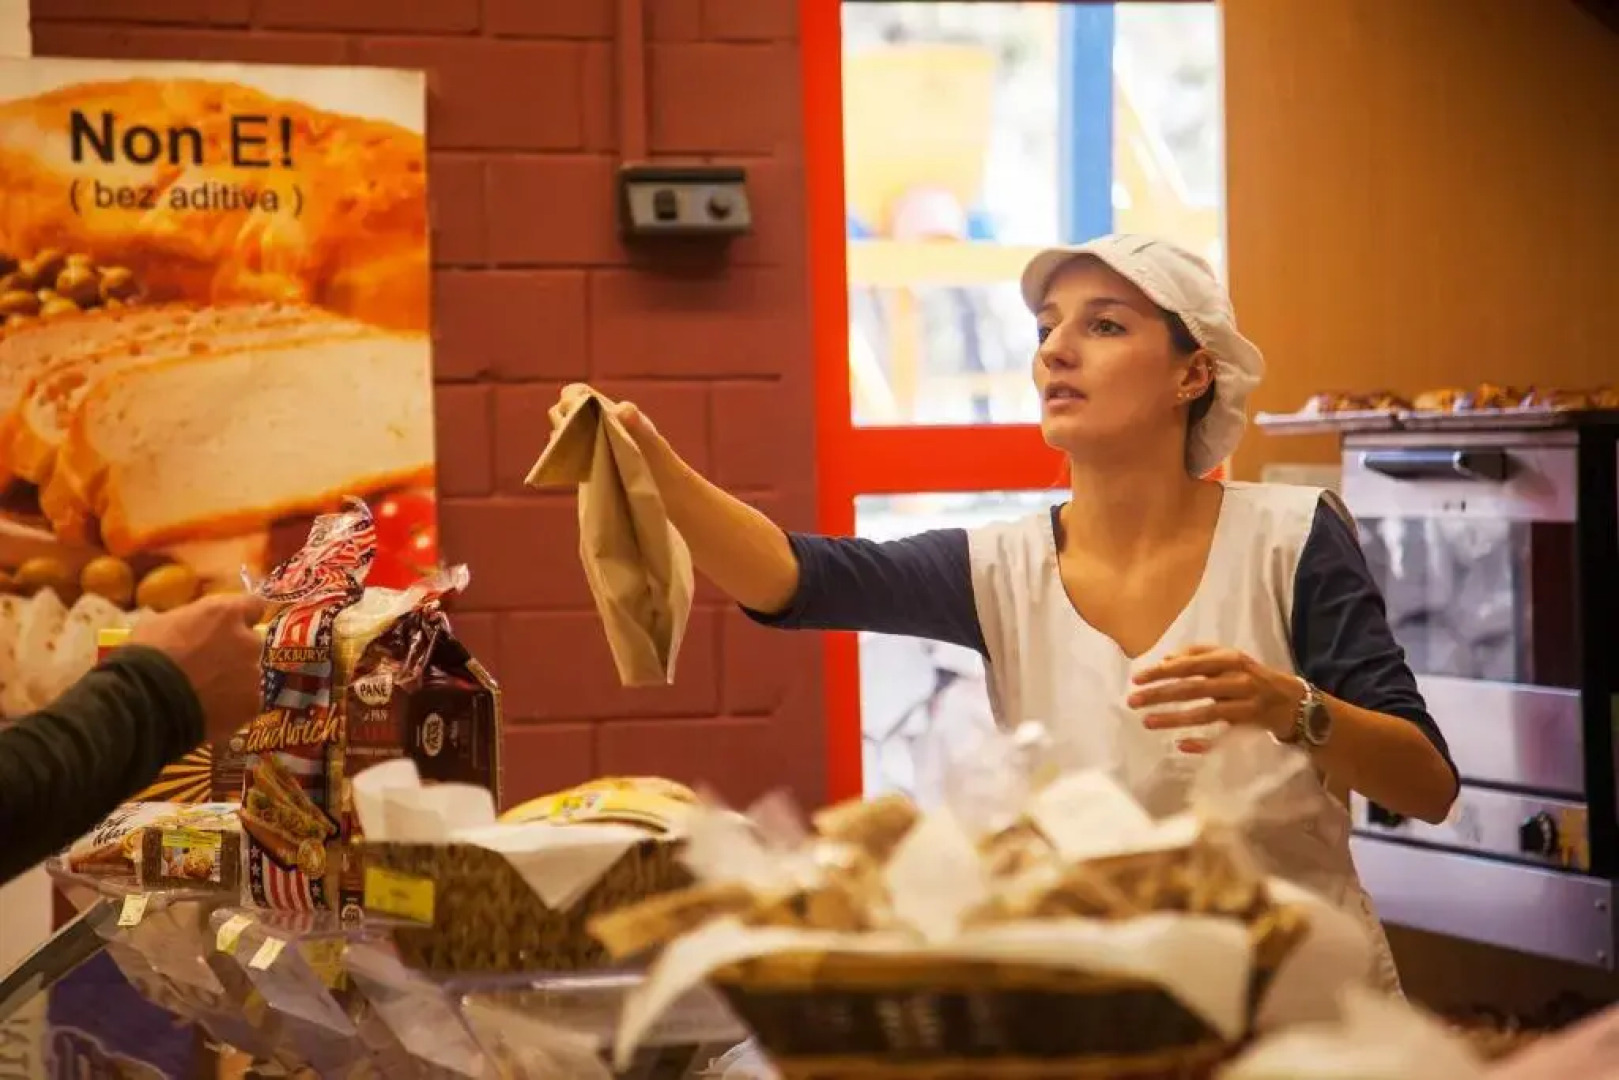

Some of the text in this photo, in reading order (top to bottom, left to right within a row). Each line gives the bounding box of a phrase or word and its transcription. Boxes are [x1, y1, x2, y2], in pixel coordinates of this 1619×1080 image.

[70, 110, 295, 168] Non E!
[94, 180, 155, 210] bez
[169, 181, 279, 213] aditiva
[361, 682, 388, 697] PANE
[246, 701, 339, 751] andwich
